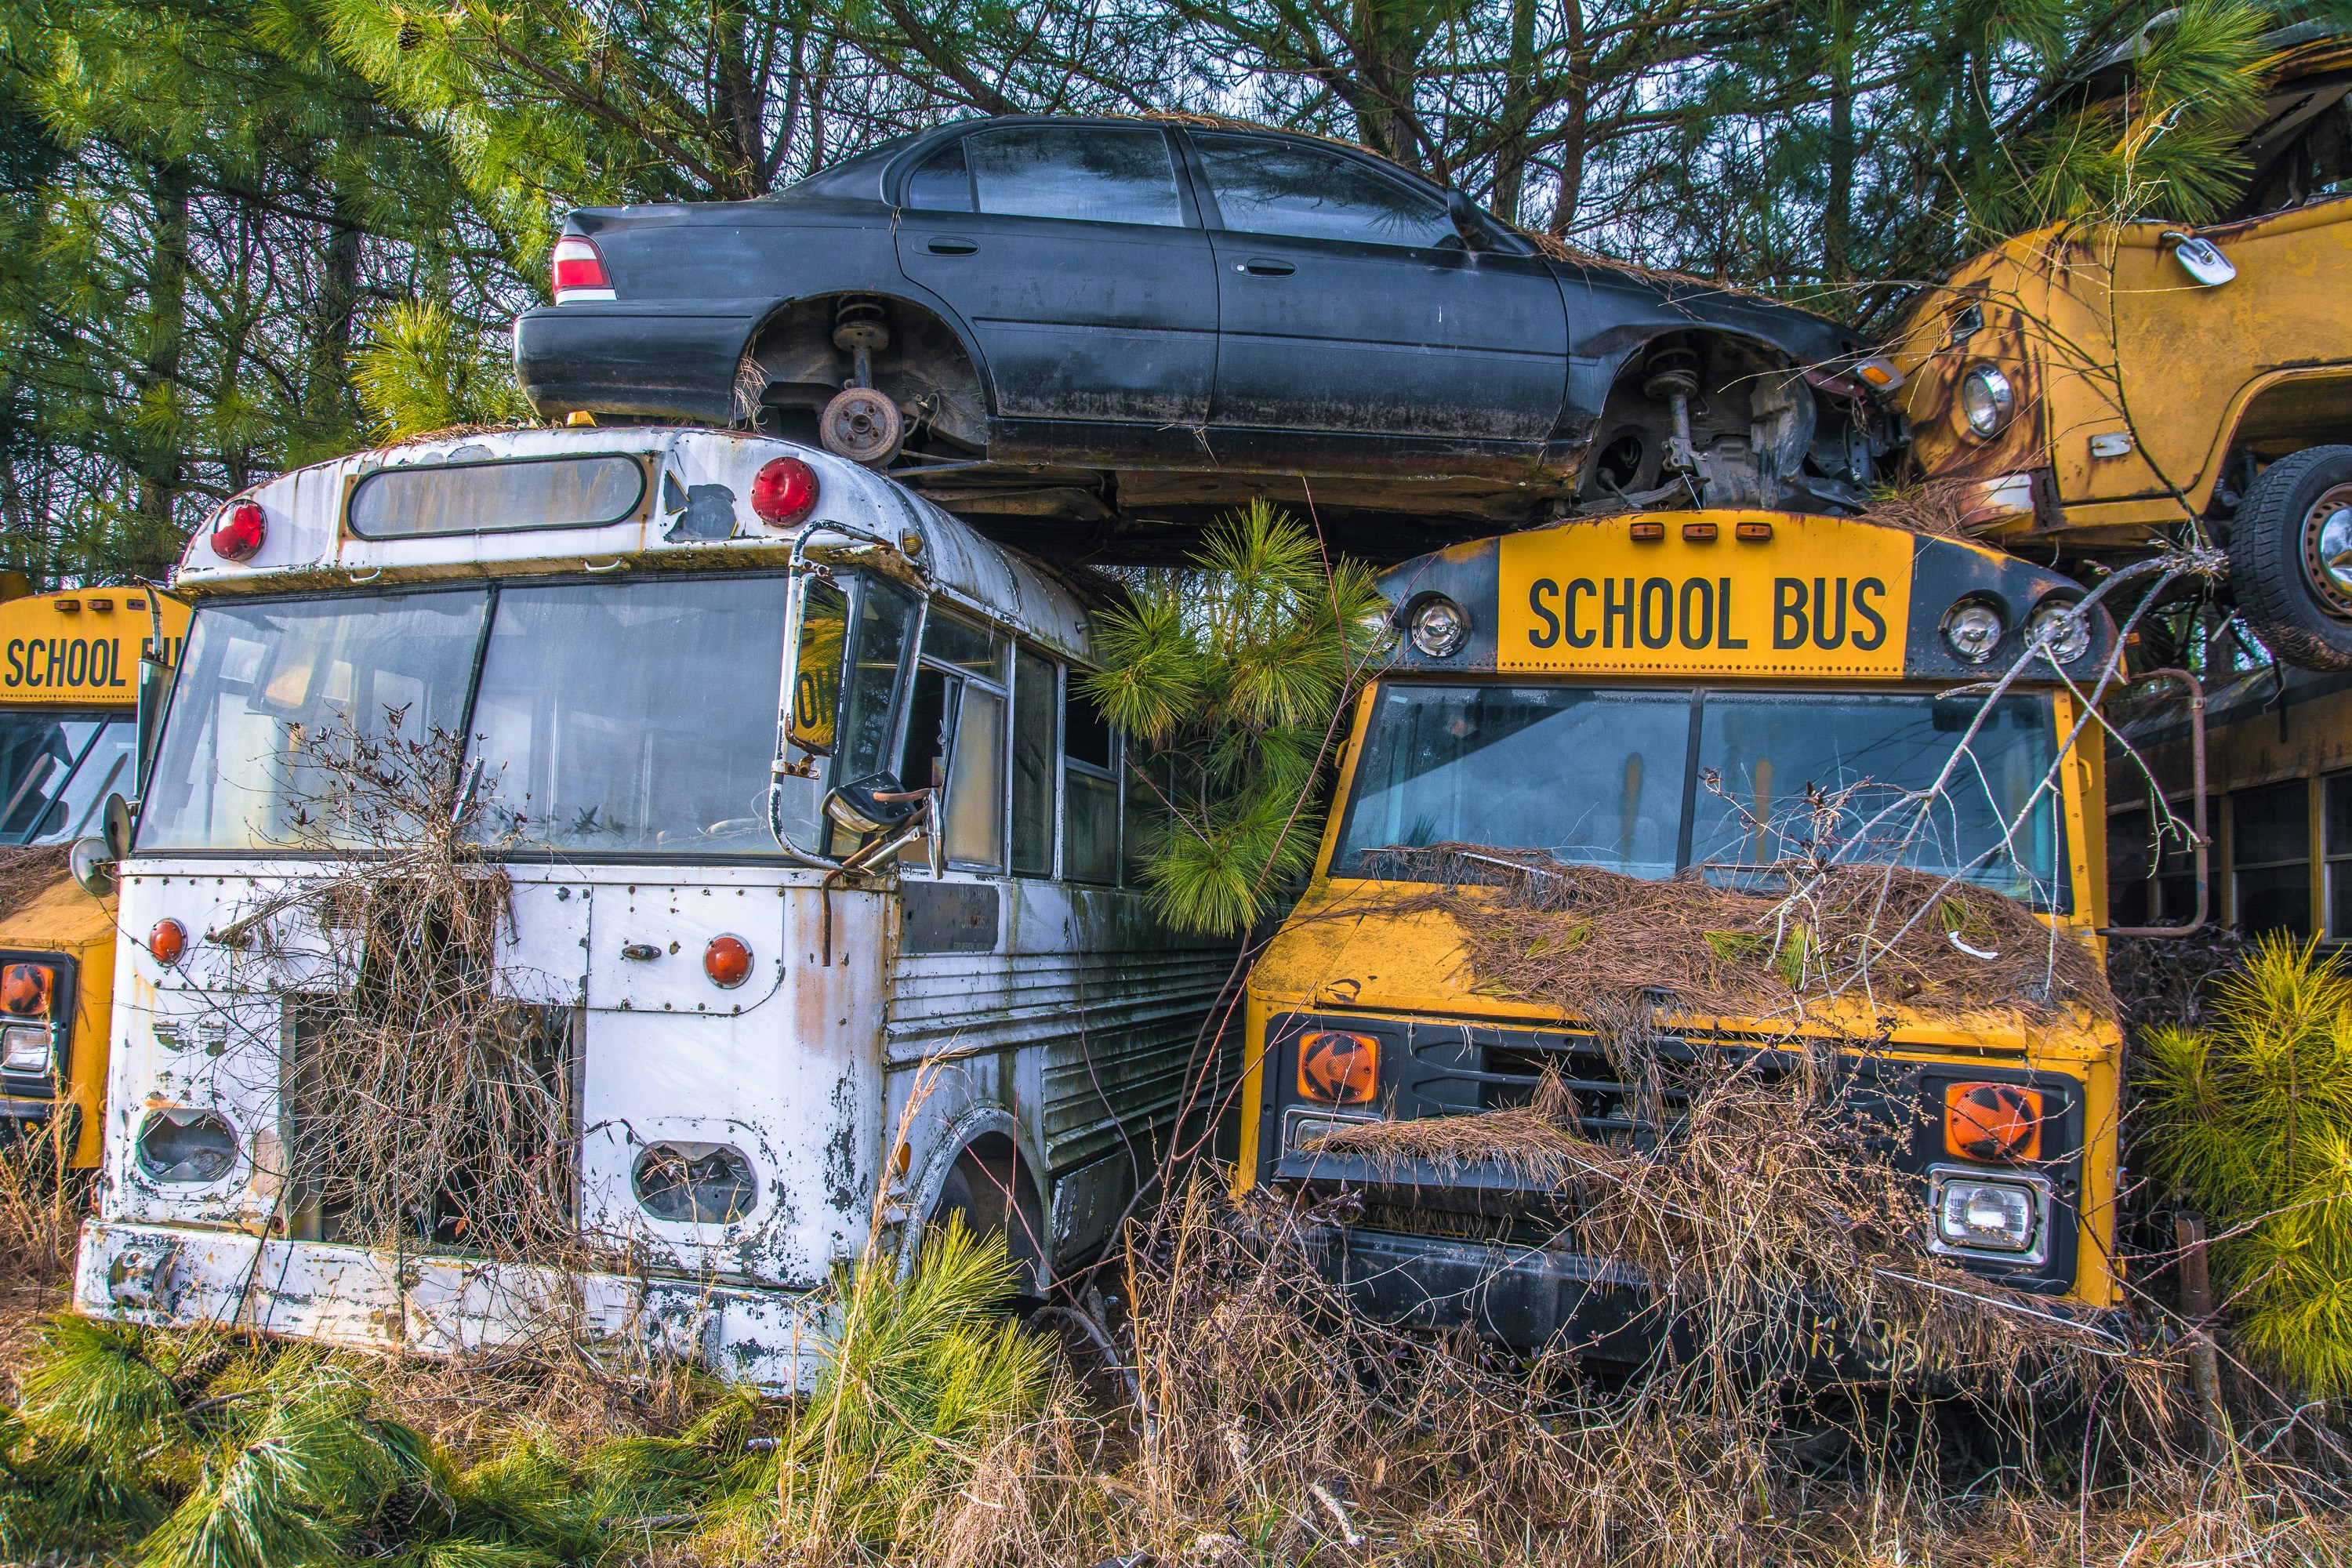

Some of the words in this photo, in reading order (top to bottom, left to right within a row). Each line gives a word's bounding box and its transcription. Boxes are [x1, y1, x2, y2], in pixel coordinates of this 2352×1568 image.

[1528, 576, 1748, 650] SCHOOL
[1773, 577, 1887, 651] BUS
[5, 637, 126, 687] SCHOOL
